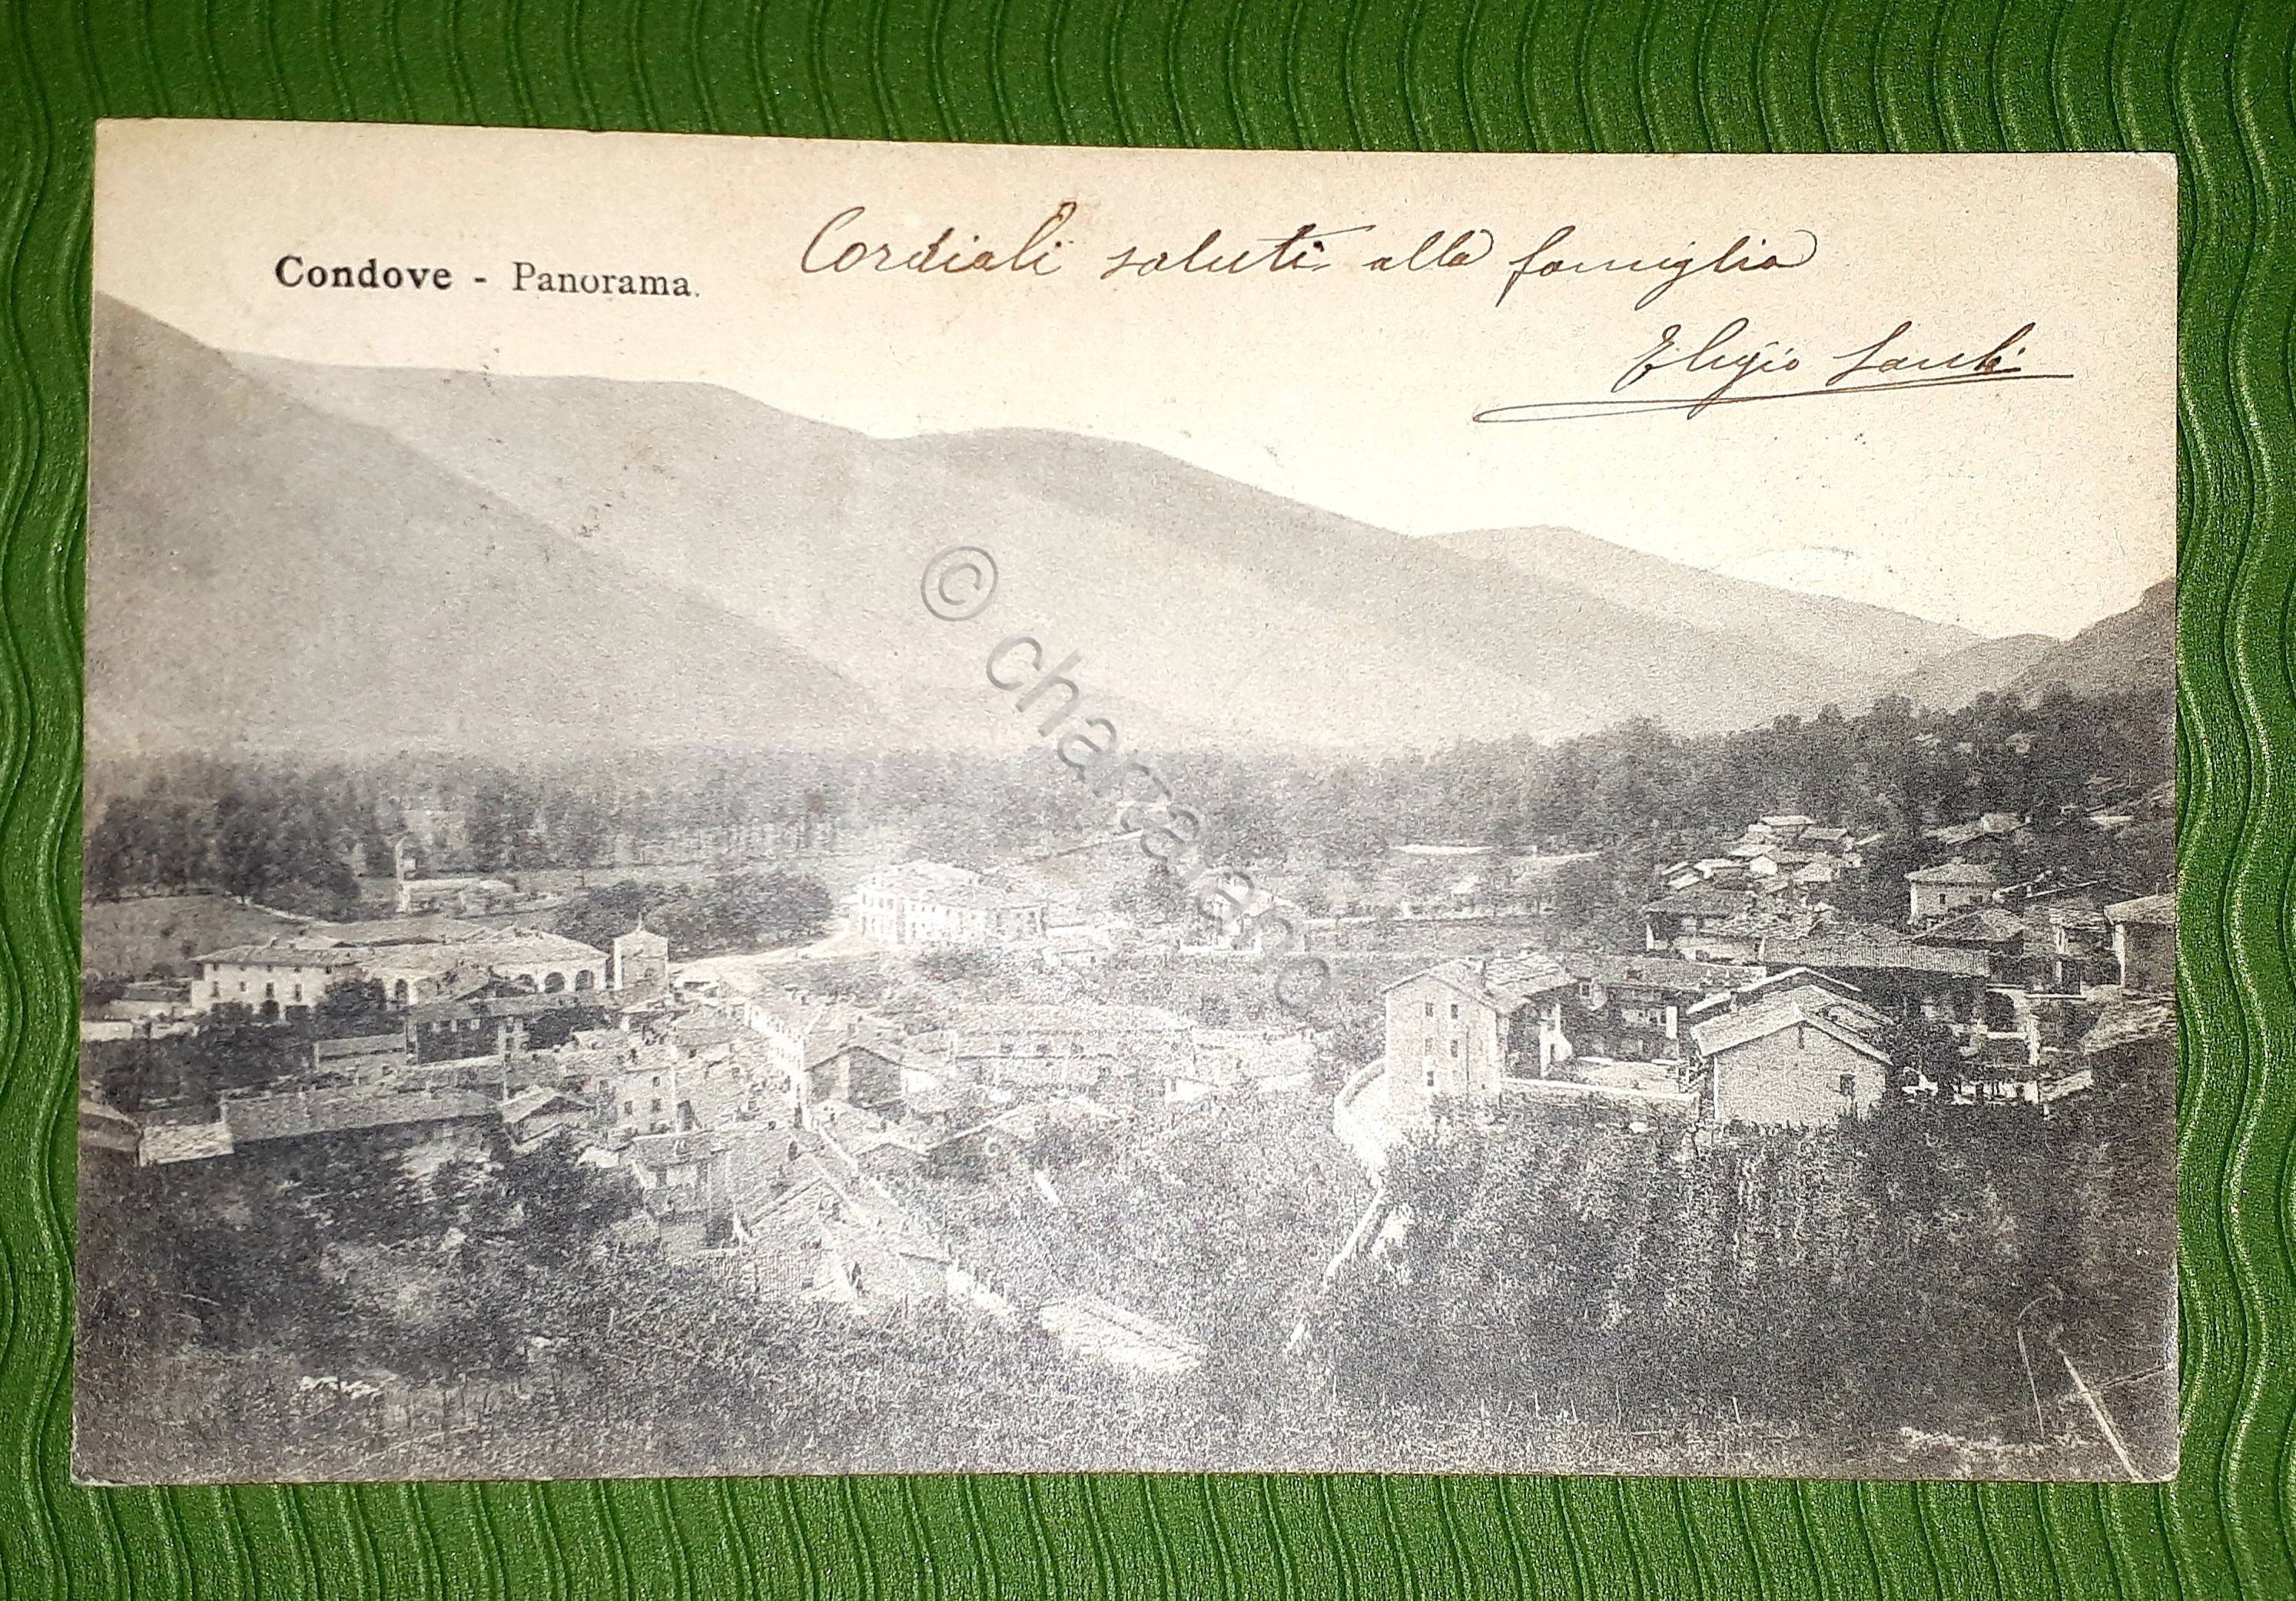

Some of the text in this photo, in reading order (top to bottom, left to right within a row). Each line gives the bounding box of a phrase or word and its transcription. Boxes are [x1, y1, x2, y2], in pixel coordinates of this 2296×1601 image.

[274, 254, 453, 290] Condove
[512, 260, 701, 299] Panorama.
[800, 200, 1818, 311] Cordiali saluti alla famiglia
